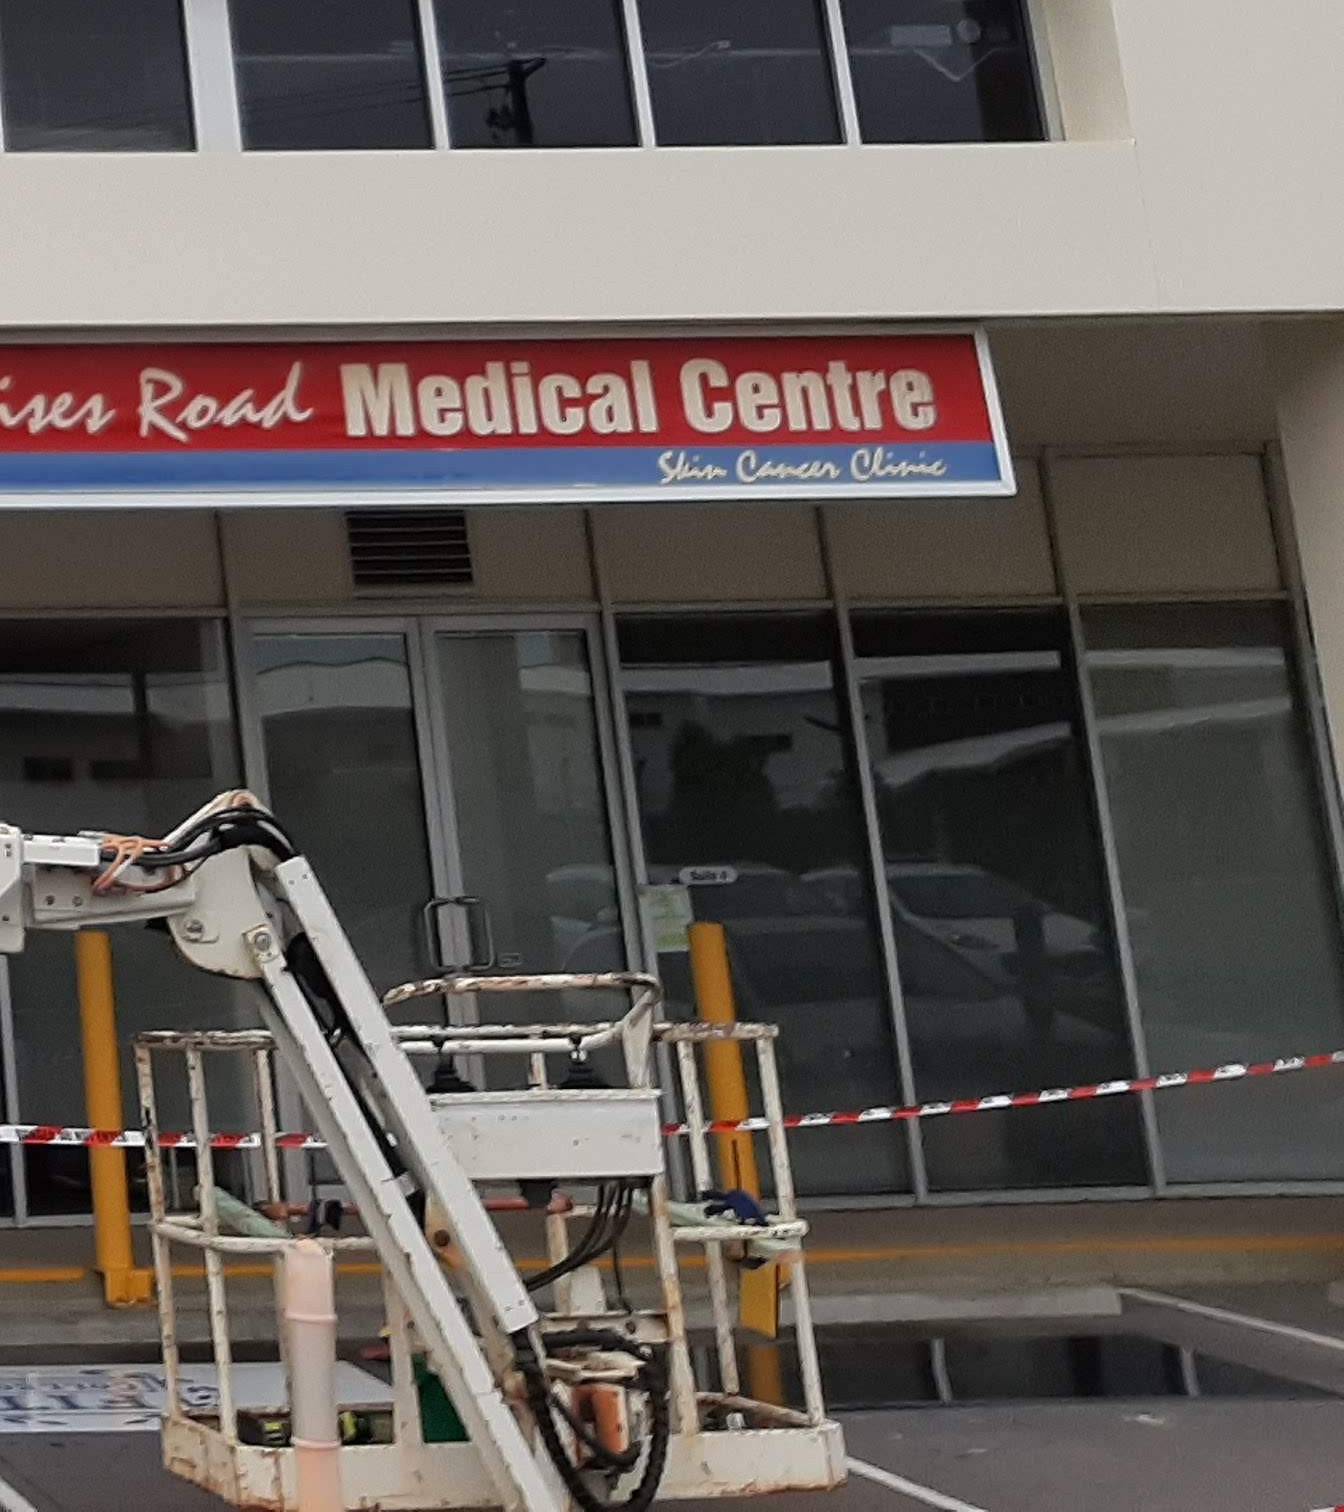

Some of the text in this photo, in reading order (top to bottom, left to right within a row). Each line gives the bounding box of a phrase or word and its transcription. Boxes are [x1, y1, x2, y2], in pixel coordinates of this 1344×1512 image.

[137, 361, 313, 443] Road
[338, 359, 661, 439] Medical
[679, 357, 939, 436] Centre
[658, 446, 948, 485] Skin Cancer Clinic
